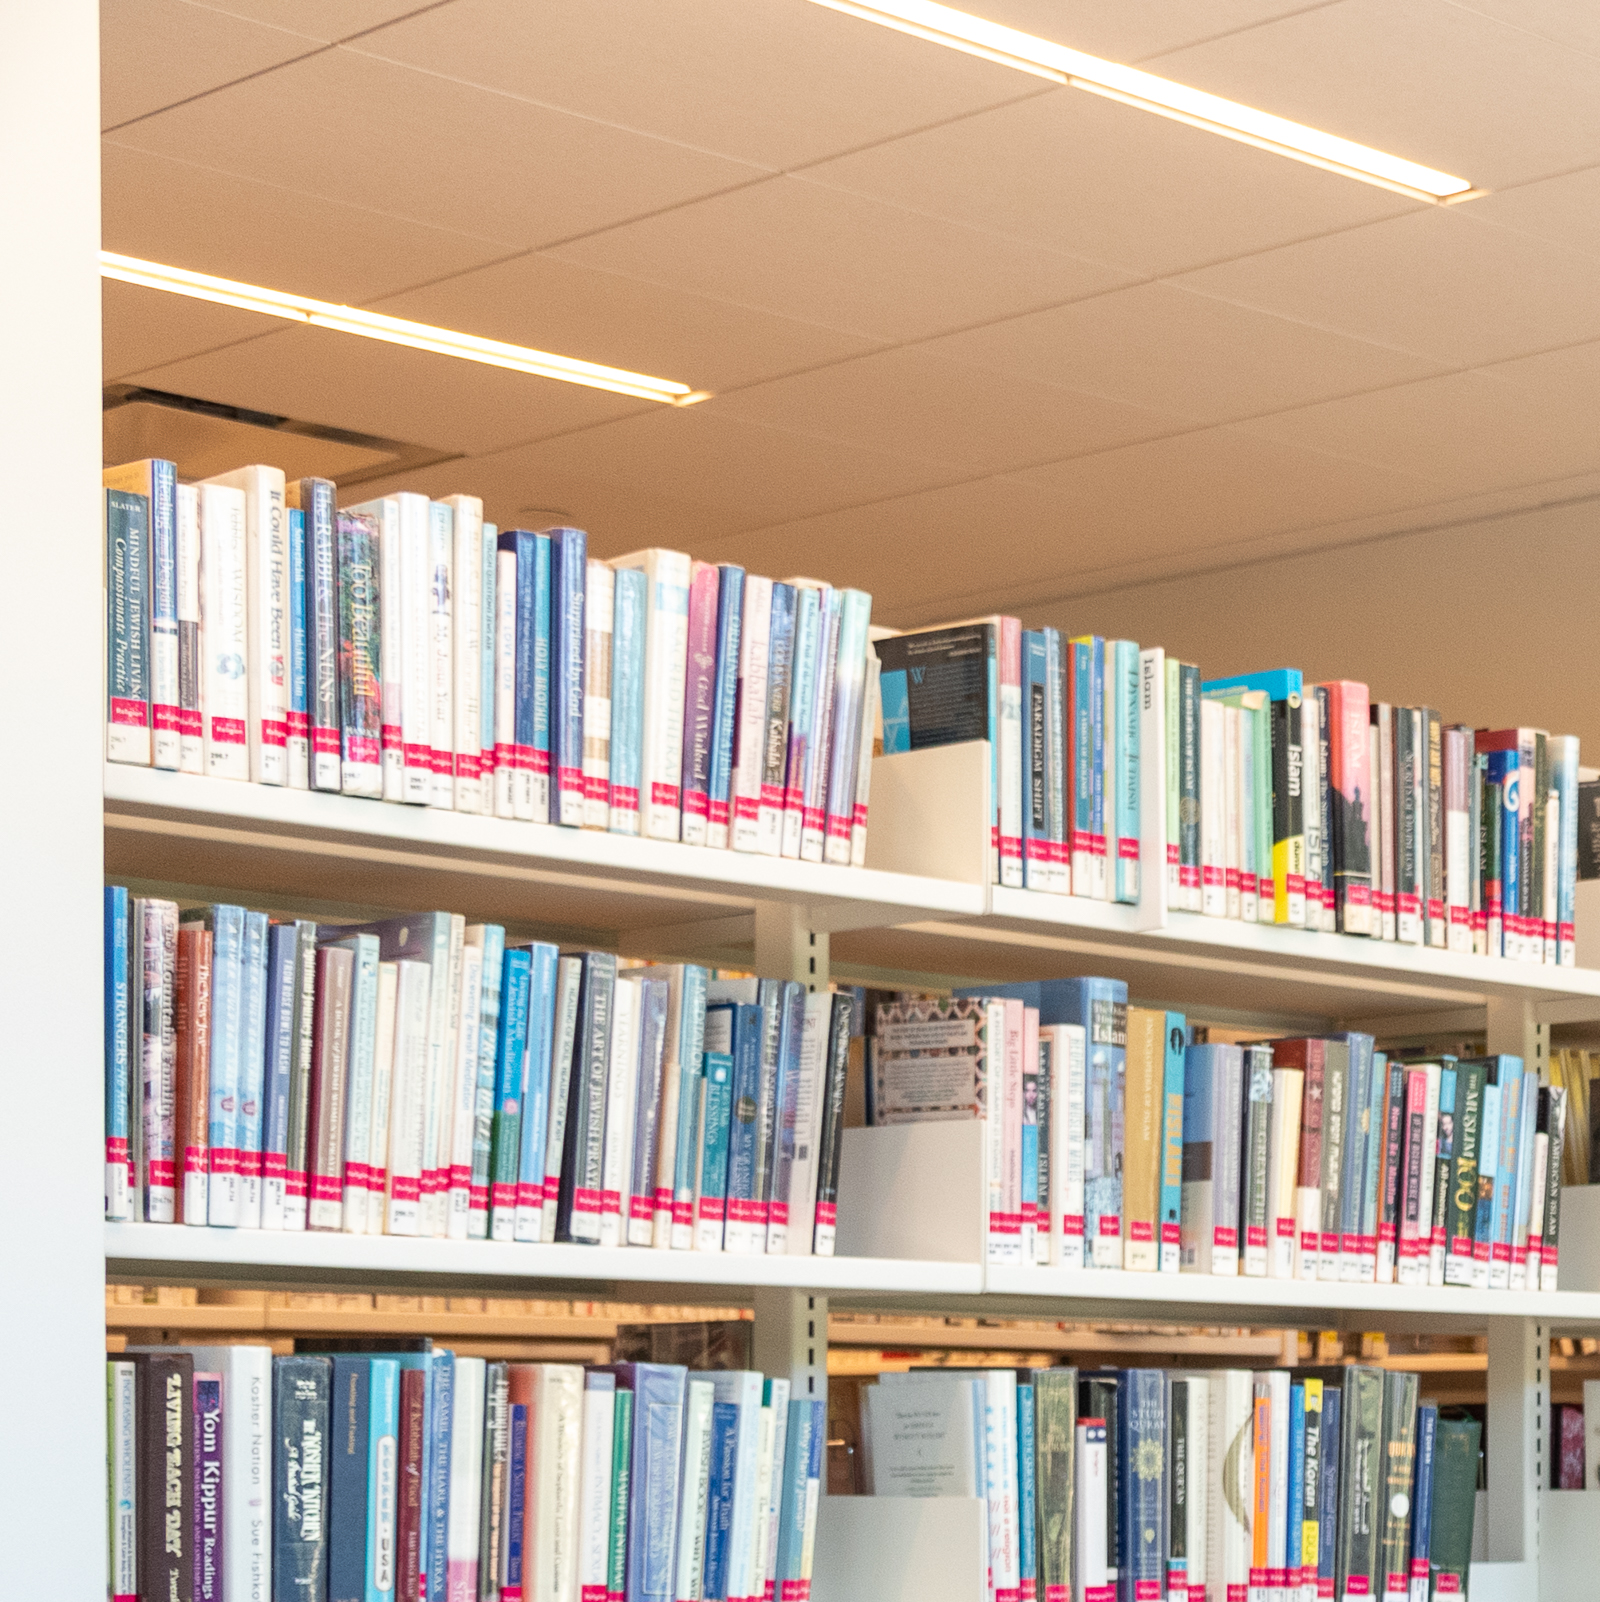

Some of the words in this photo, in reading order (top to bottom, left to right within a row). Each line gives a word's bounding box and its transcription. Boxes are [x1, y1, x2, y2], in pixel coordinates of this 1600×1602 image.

[110, 500, 142, 513] SLATER
[270, 489, 281, 500] It
[270, 507, 284, 550] Could
[129, 527, 141, 593] MINDFUL
[271, 556, 284, 603] Have
[351, 559, 372, 600] Too
[114, 537, 127, 631] Compassionate
[130, 596, 141, 642] JEWISH
[270, 607, 284, 650] Been
[115, 636, 126, 693] Practice
[351, 604, 376, 698] Beautiful
[536, 638, 546, 672] HOLY
[534, 676, 547, 732] BROTHER
[570, 683, 582, 718] God
[1143, 657, 1155, 711] Islam
[115, 708, 143, 717] Religion
[217, 725, 243, 734] Religion
[1032, 691, 1043, 771] PARADIGM
[1288, 744, 1302, 797] Islam
[1033, 776, 1043, 822] SHIFT
[283, 959, 293, 981] FROM
[161, 949, 175, 1047] Mountain
[282, 985, 292, 1007] ROSE
[594, 994, 608, 1022] THE
[281, 1010, 291, 1033] BOWL
[592, 1027, 606, 1053] ART
[1091, 1027, 1127, 1044] Islam
[156, 1052, 173, 1120] Family
[278, 1051, 289, 1075] RASHI
[591, 1057, 604, 1078] OF
[588, 1079, 604, 1124] JEWISH
[706, 1083, 719, 1146] BLESSINGS
[586, 1127, 601, 1190] PRAYE
[1552, 1138, 1560, 1191] AMERICAN
[165, 1373, 182, 1447] LIVING
[250, 1376, 260, 1428] Kosher
[203, 1408, 221, 1453] Yom
[1307, 1426, 1320, 1456] The
[165, 1449, 182, 1507] EACH
[250, 1434, 260, 1485] Nation
[1305, 1457, 1319, 1508] Koran
[200, 1460, 221, 1536] Kippur
[165, 1509, 183, 1558] DAY
[250, 1519, 263, 1544] Sue
[203, 1538, 217, 1600] Readings
